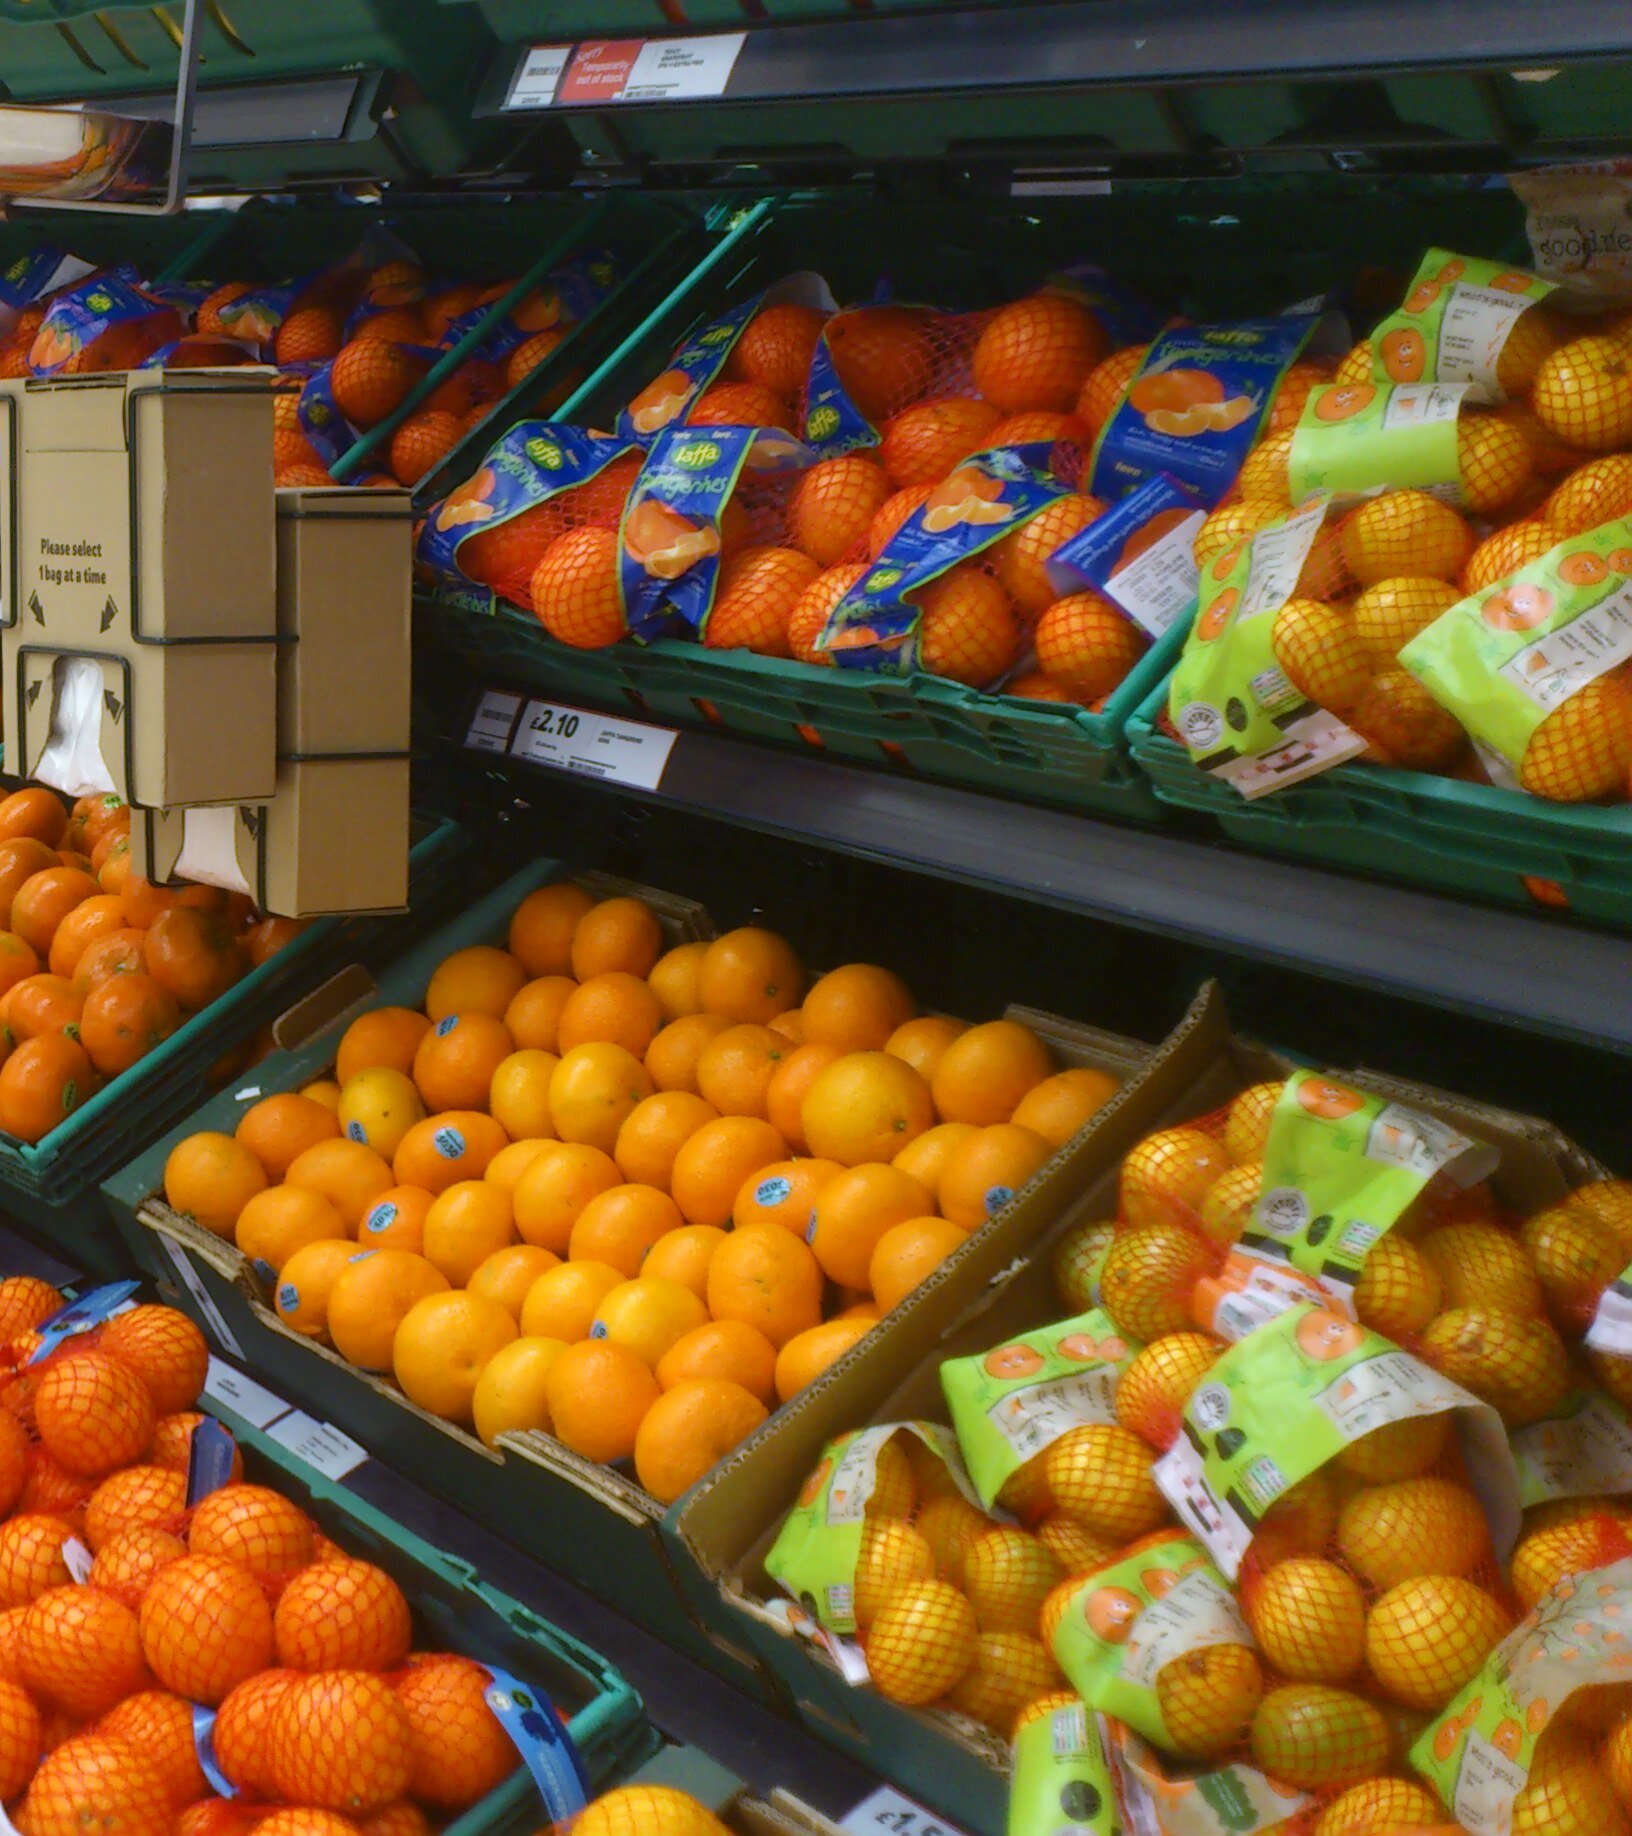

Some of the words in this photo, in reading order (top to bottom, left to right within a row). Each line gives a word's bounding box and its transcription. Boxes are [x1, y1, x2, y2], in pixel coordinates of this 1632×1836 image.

[673, 443, 719, 466] Jaffa
[40, 537, 71, 557] Please
[71, 539, 103, 558] select
[38, 564, 45, 581] 1
[45, 564, 63, 586] bag
[64, 567, 74, 584] at
[75, 570, 82, 584] a
[82, 566, 107, 585] time
[529, 708, 581, 739] £2.10
